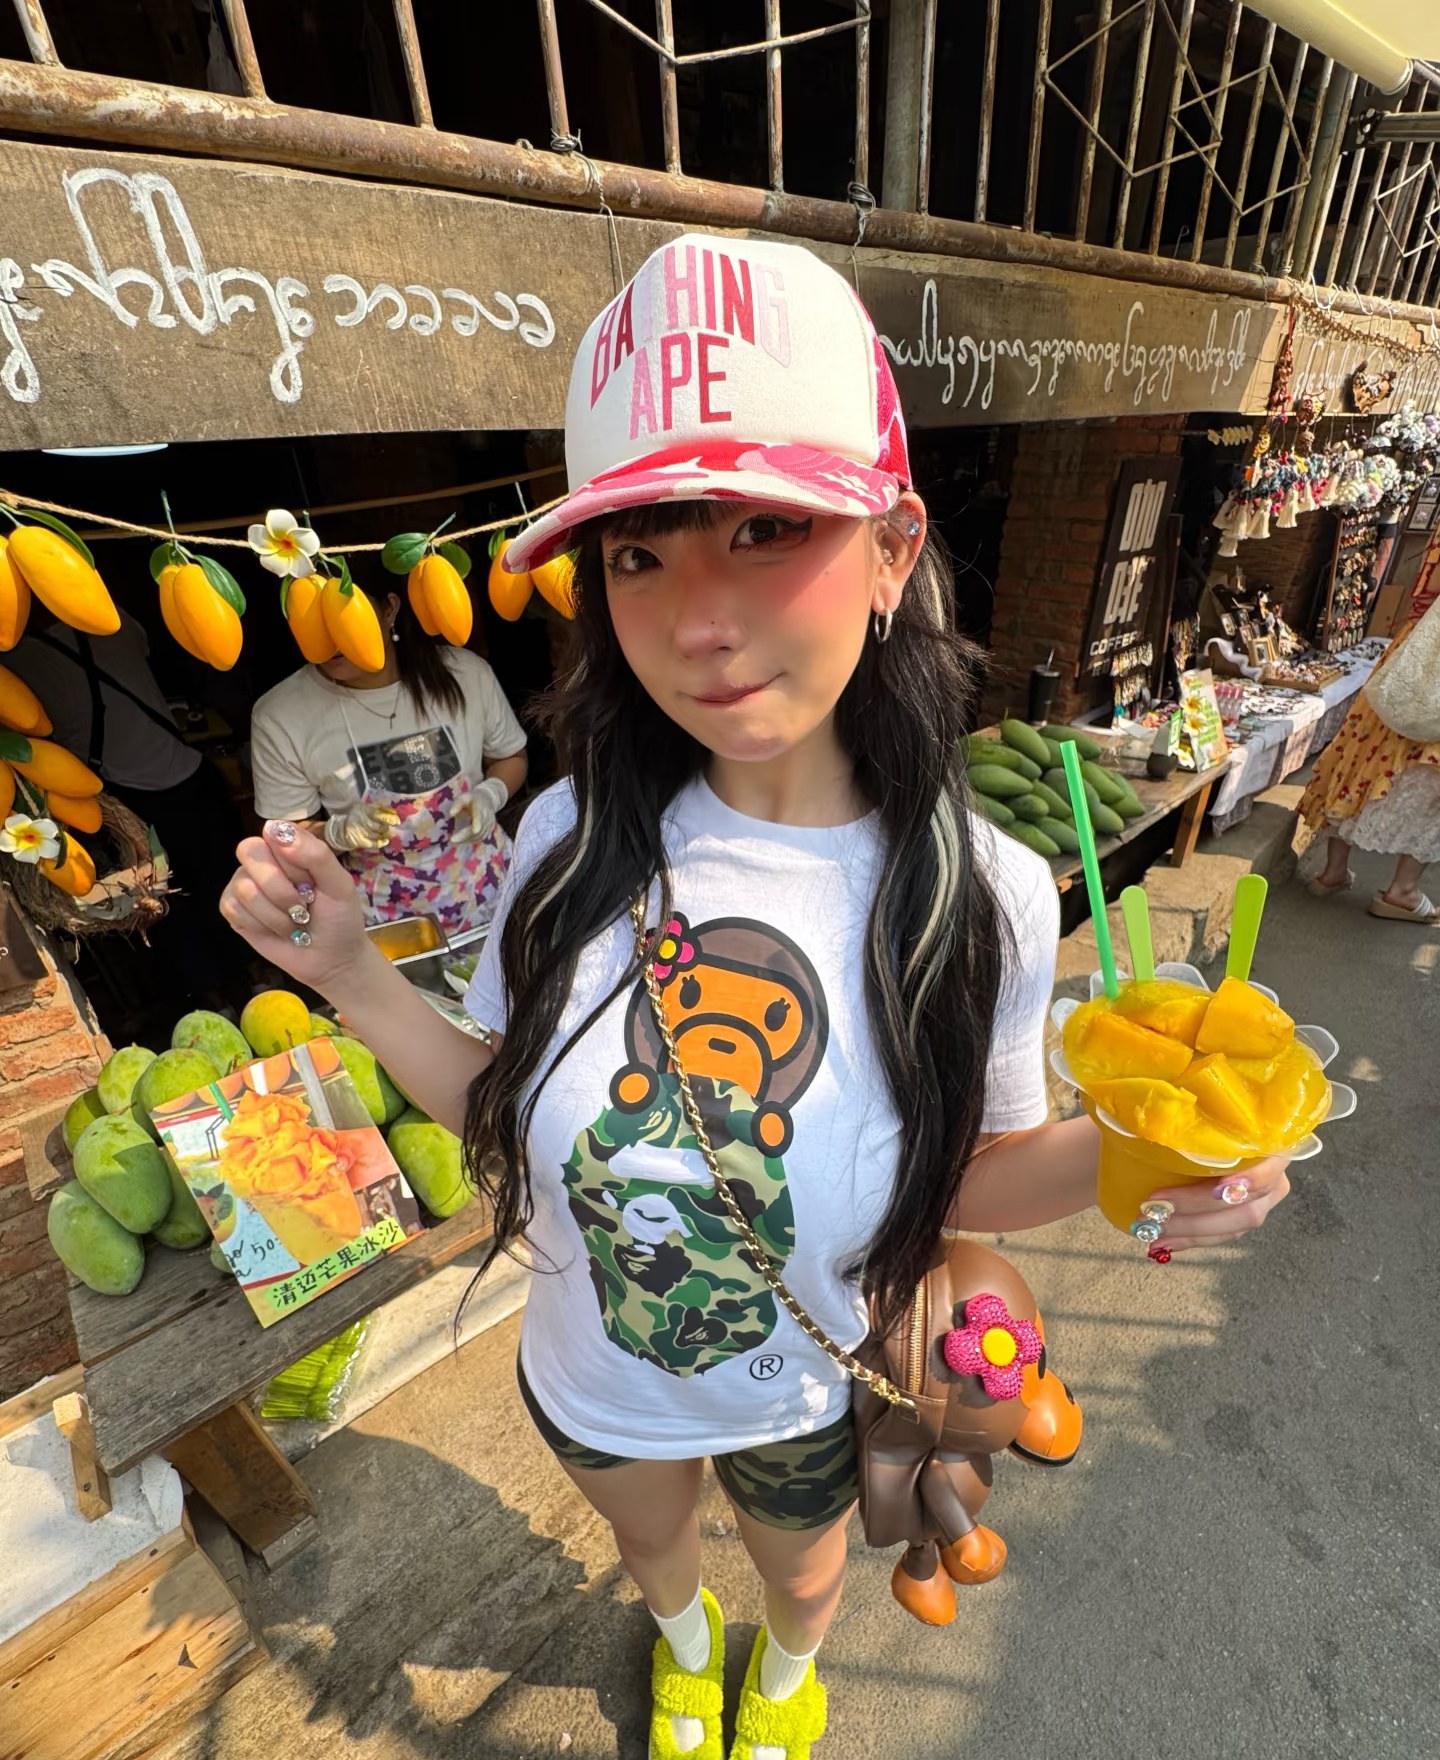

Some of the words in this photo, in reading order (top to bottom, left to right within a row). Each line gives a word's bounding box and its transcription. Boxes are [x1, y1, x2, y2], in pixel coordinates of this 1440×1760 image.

[629, 331, 732, 440] APE
[272, 1221, 399, 1308] 清迈芒果冰沙
